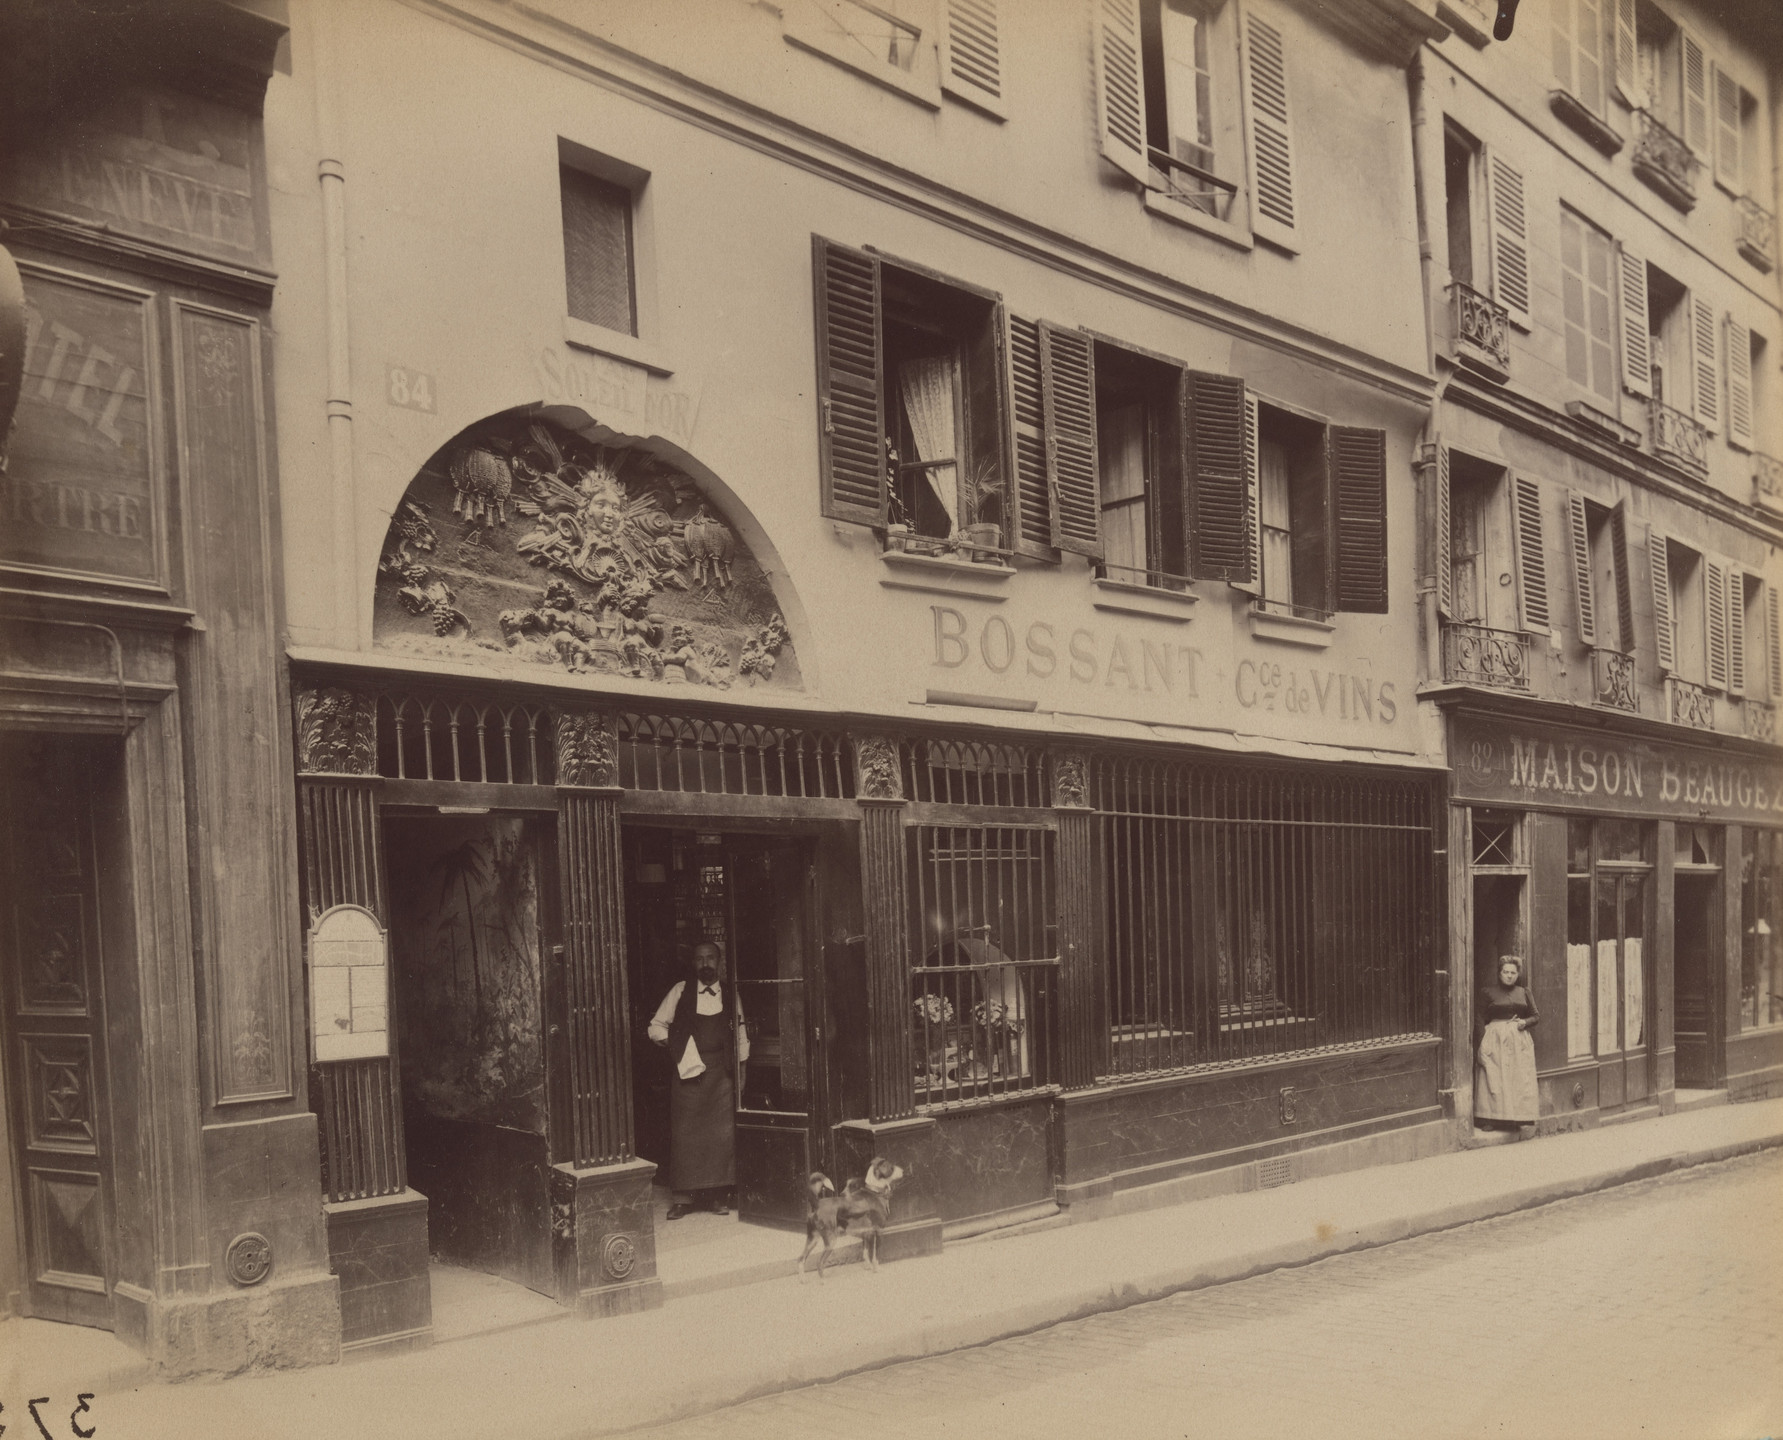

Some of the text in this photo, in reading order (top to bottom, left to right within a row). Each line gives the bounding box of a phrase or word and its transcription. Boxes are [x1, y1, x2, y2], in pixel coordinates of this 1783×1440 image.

[390, 368, 432, 410] 84
[10, 476, 143, 541] RTRE
[930, 605, 1203, 698] BOSSANT
[1310, 669, 1397, 724] VINS
[1471, 741, 1492, 773] 82
[1510, 735, 1644, 797] MAISON
